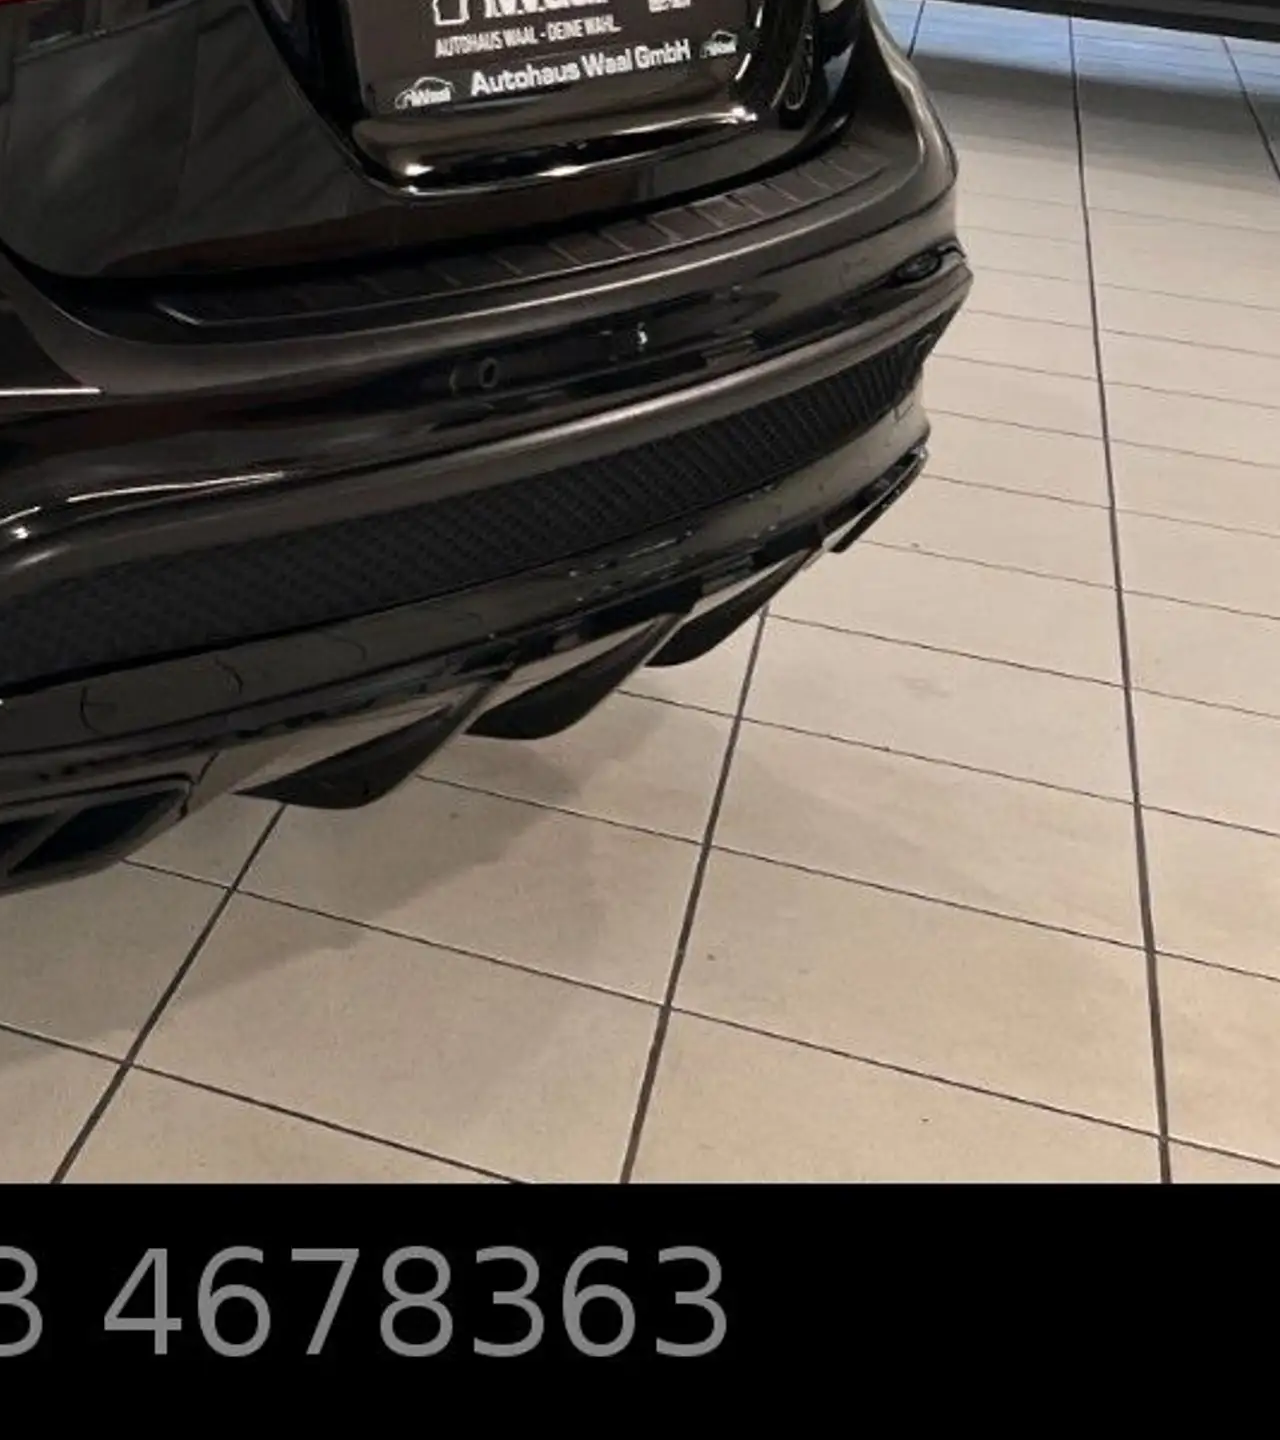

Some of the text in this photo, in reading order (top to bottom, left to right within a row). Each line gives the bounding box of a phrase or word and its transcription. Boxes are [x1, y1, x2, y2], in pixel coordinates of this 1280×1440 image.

[435, 30, 503, 58] AUTOHAUS
[470, 38, 691, 97] Autohaus Waal GmbH
